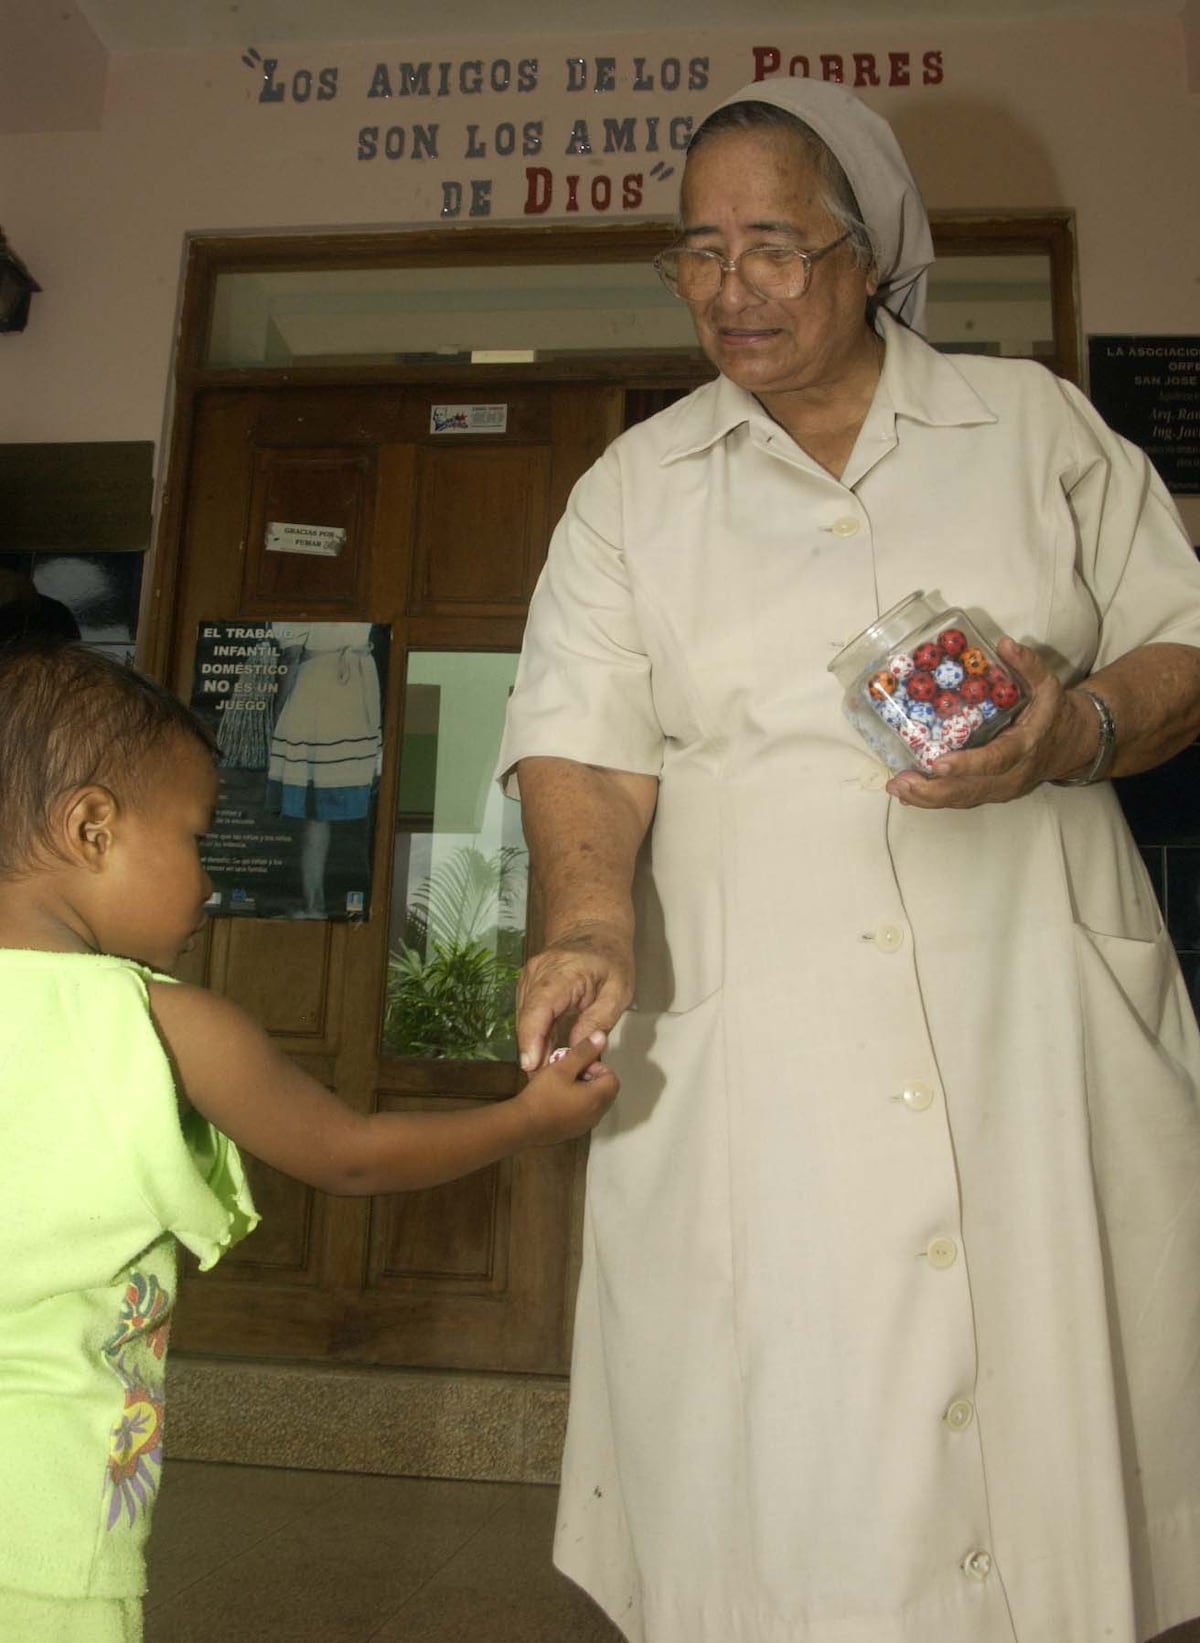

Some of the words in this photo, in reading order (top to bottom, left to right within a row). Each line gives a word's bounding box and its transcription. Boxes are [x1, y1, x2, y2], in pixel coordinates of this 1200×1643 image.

[366, 58, 539, 98] AMIGOS
[565, 58, 616, 92] DE
[633, 57, 710, 91] LOS
[752, 47, 944, 88] POBRES
[357, 123, 440, 161] SON
[464, 121, 545, 159] LOS
[441, 180, 493, 218] DE
[1106, 347, 1124, 357] LA
[1128, 347, 1200, 357] ASOCIACIO
[203, 628, 221, 638] EL
[213, 645, 281, 657] INFANTIL
[204, 679, 230, 693] NO
[234, 681, 253, 693] ES
[257, 682, 279, 693] UN
[215, 700, 266, 711] JUEGO
